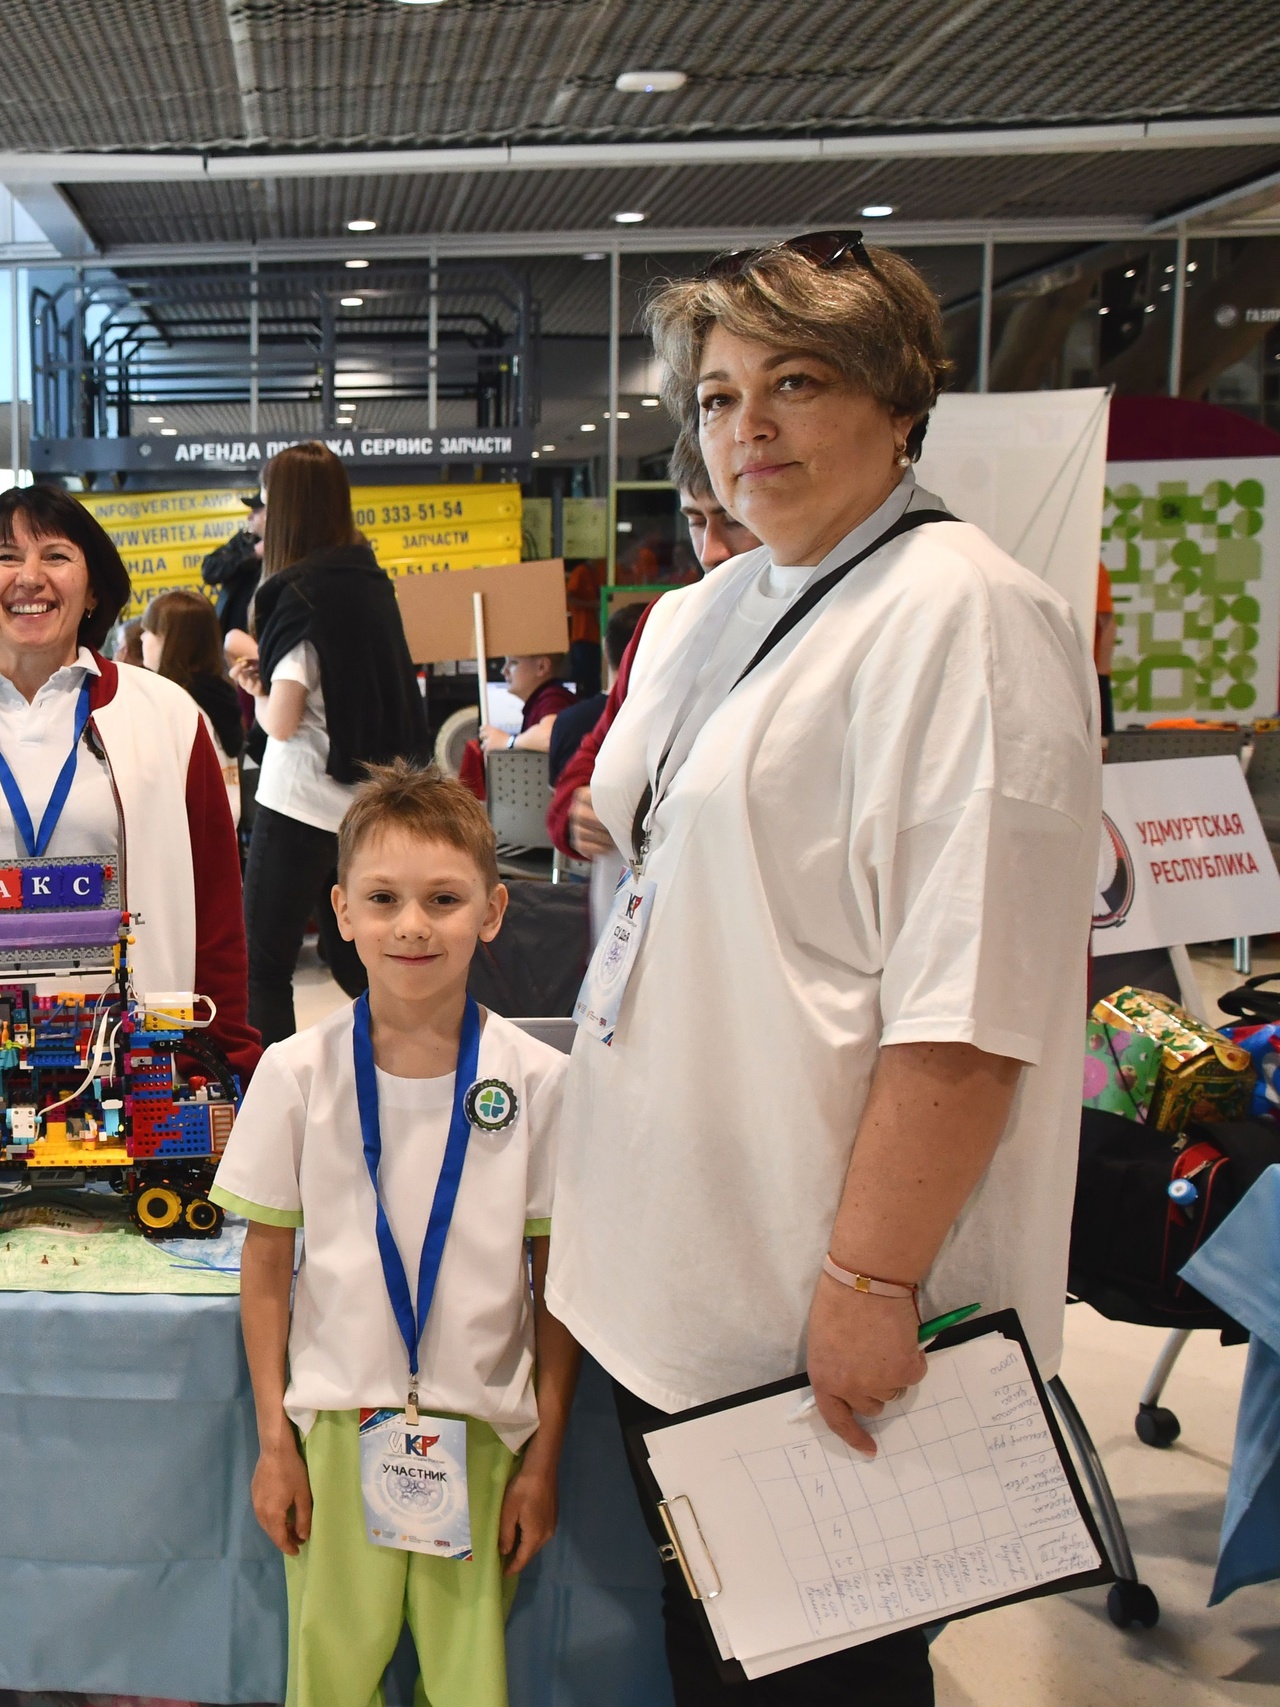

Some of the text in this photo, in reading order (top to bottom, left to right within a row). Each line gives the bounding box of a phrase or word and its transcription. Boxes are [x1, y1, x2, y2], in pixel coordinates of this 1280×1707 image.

[175, 442, 261, 463] АРЕНДА
[361, 437, 433, 456] СЕРВИС
[440, 436, 512, 454] ЗАПЧАСТИ
[403, 531, 469, 549] ЗАПЧАСТИ
[1136, 813, 1245, 846] УДМУРТСКАЯ
[1150, 852, 1259, 884] РЕСПУБЛИКА
[382, 1463, 448, 1482] УЧАСТНИК
